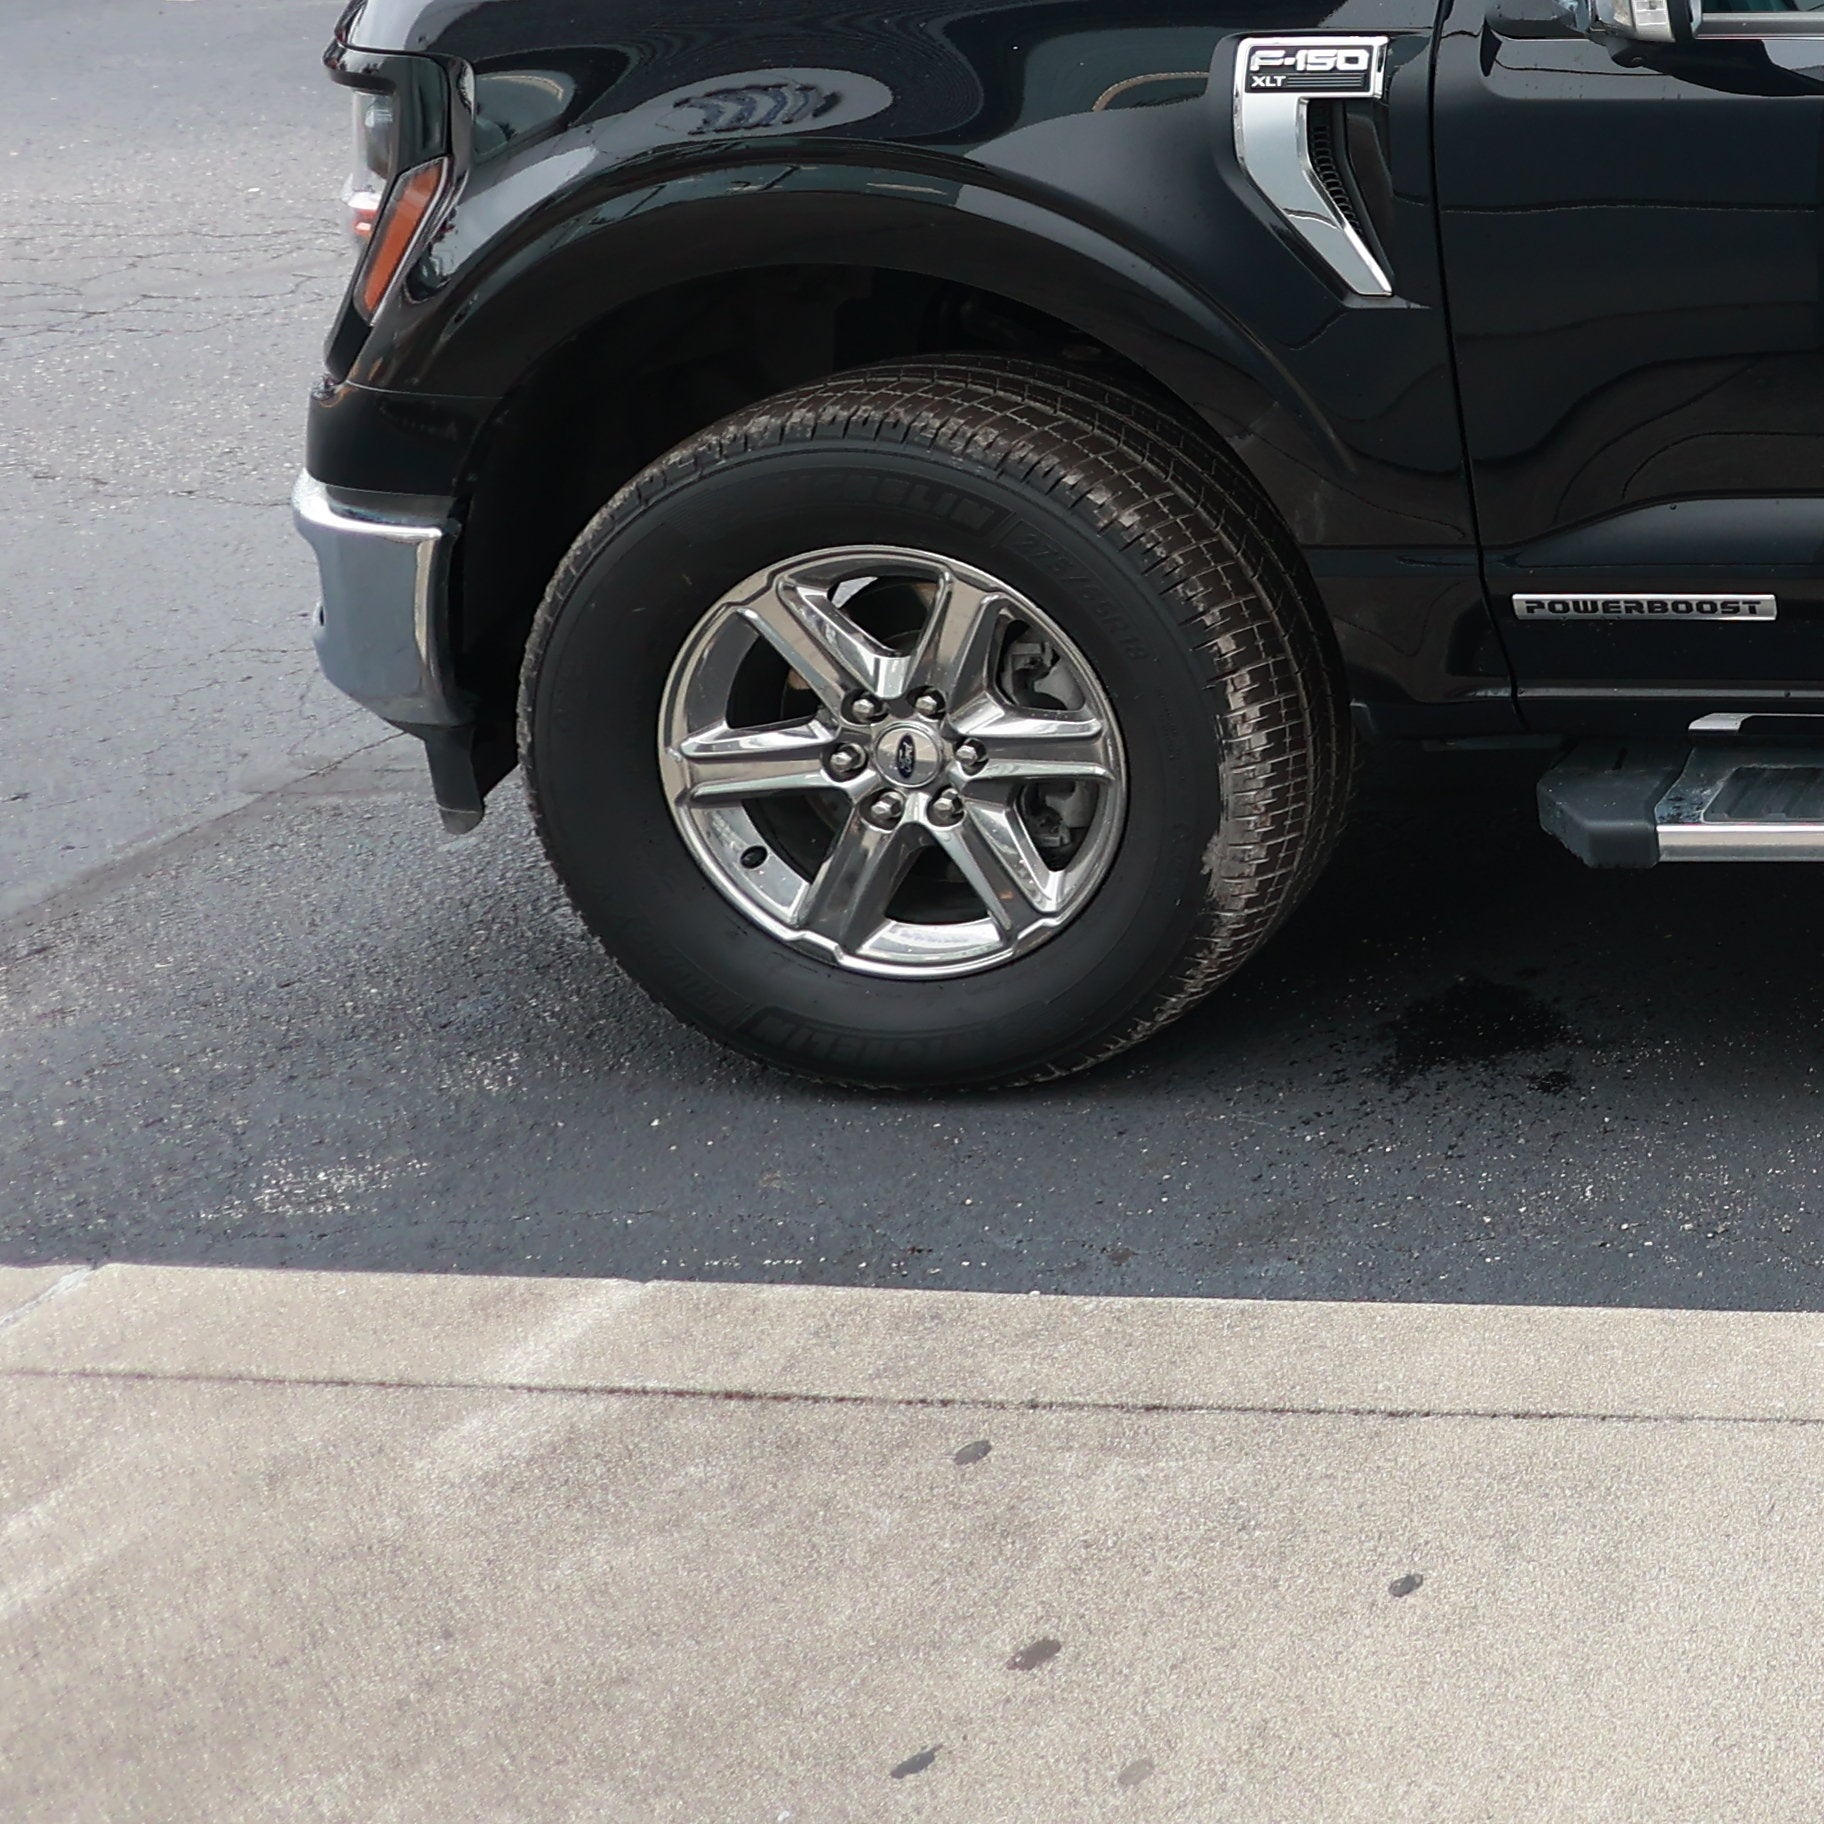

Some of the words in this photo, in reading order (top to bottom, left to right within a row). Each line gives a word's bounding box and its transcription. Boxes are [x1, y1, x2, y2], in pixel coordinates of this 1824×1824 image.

[1250, 49, 1369, 72] F-150
[1251, 76, 1286, 87] XLT
[1525, 599, 1761, 615] POWERBOOST
